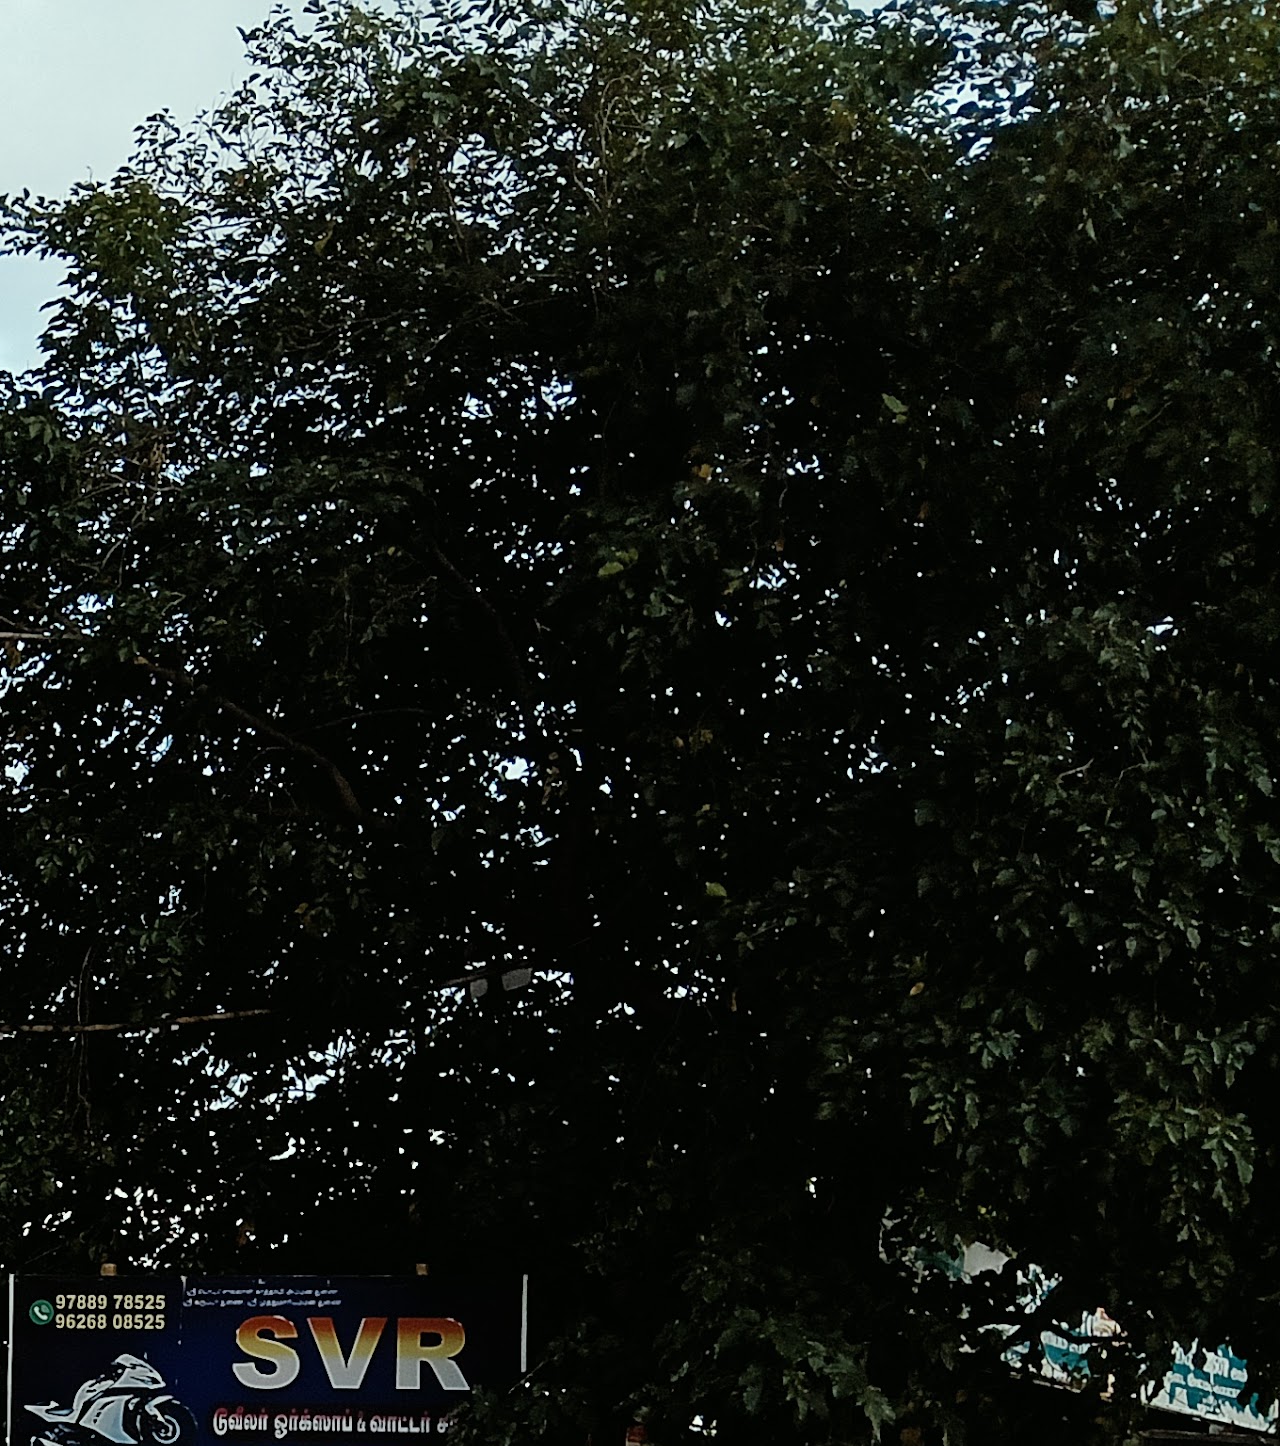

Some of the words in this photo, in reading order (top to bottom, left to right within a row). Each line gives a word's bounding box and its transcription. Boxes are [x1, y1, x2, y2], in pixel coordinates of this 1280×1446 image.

[55, 1294, 108, 1310] 97889
[112, 1294, 166, 1310] 78525
[55, 1313, 108, 1330] 96268
[112, 1313, 166, 1330] 08525
[232, 1315, 471, 1391] SVR
[356, 1409, 367, 1433] &
[369, 1409, 431, 1434] வாட்டர்
